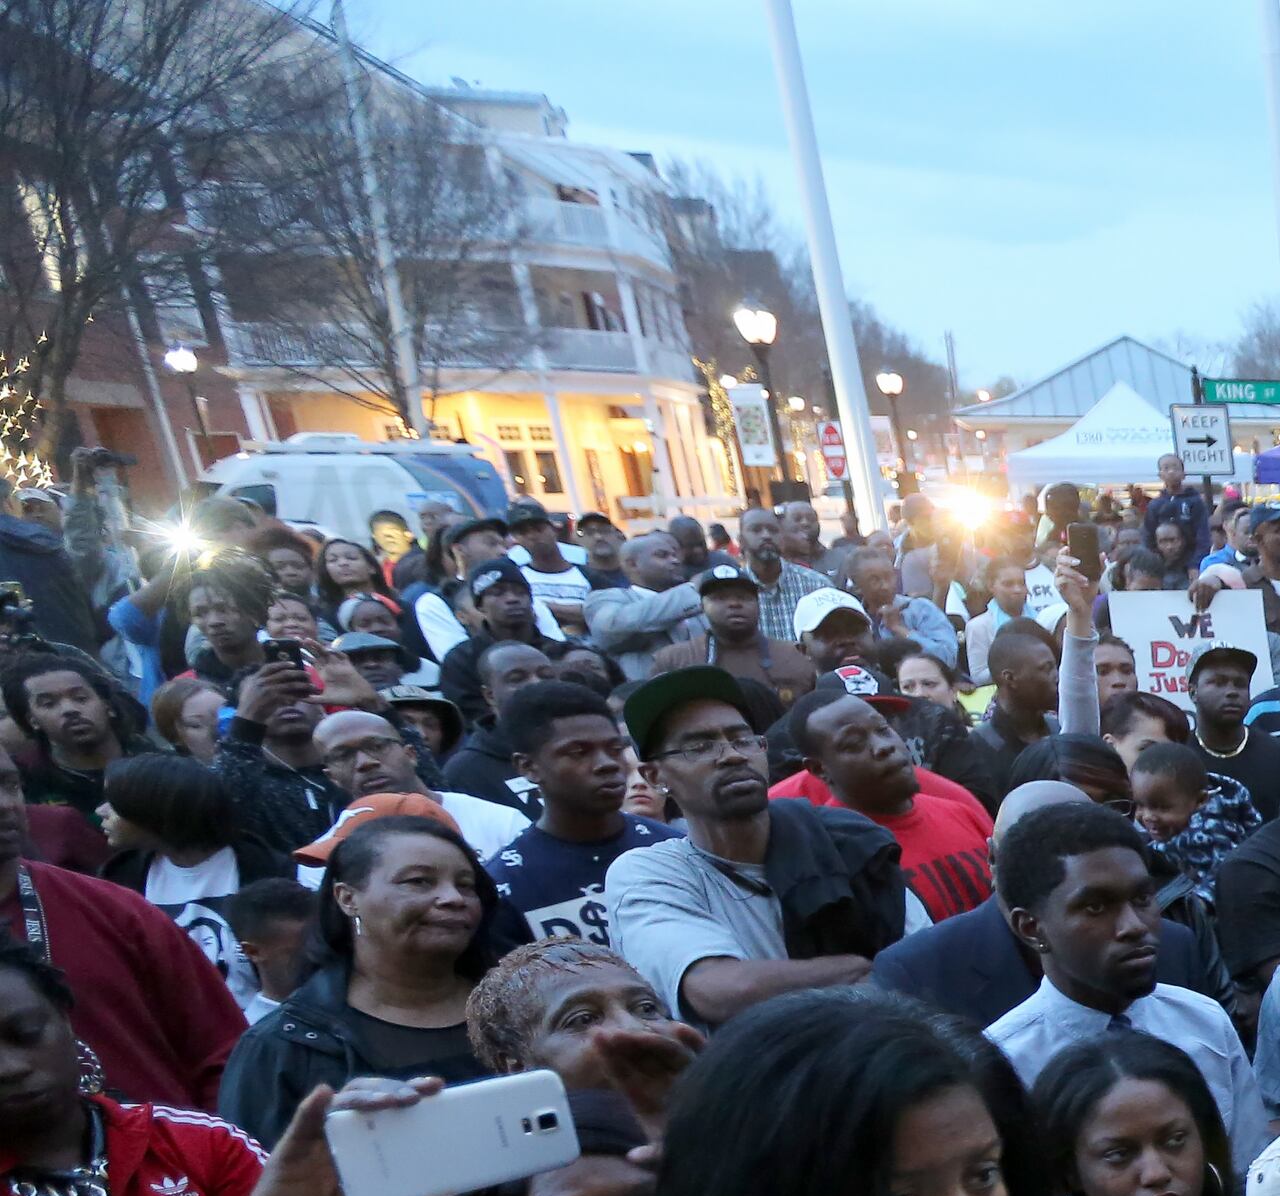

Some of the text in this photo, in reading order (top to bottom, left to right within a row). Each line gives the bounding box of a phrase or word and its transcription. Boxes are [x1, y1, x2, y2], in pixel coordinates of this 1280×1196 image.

[1215, 383, 1256, 400] KING
[1181, 415, 1218, 428] KEEP
[1182, 449, 1226, 464] RIGHT
[1168, 612, 1215, 638] WE
[1149, 672, 1193, 694] Jus
